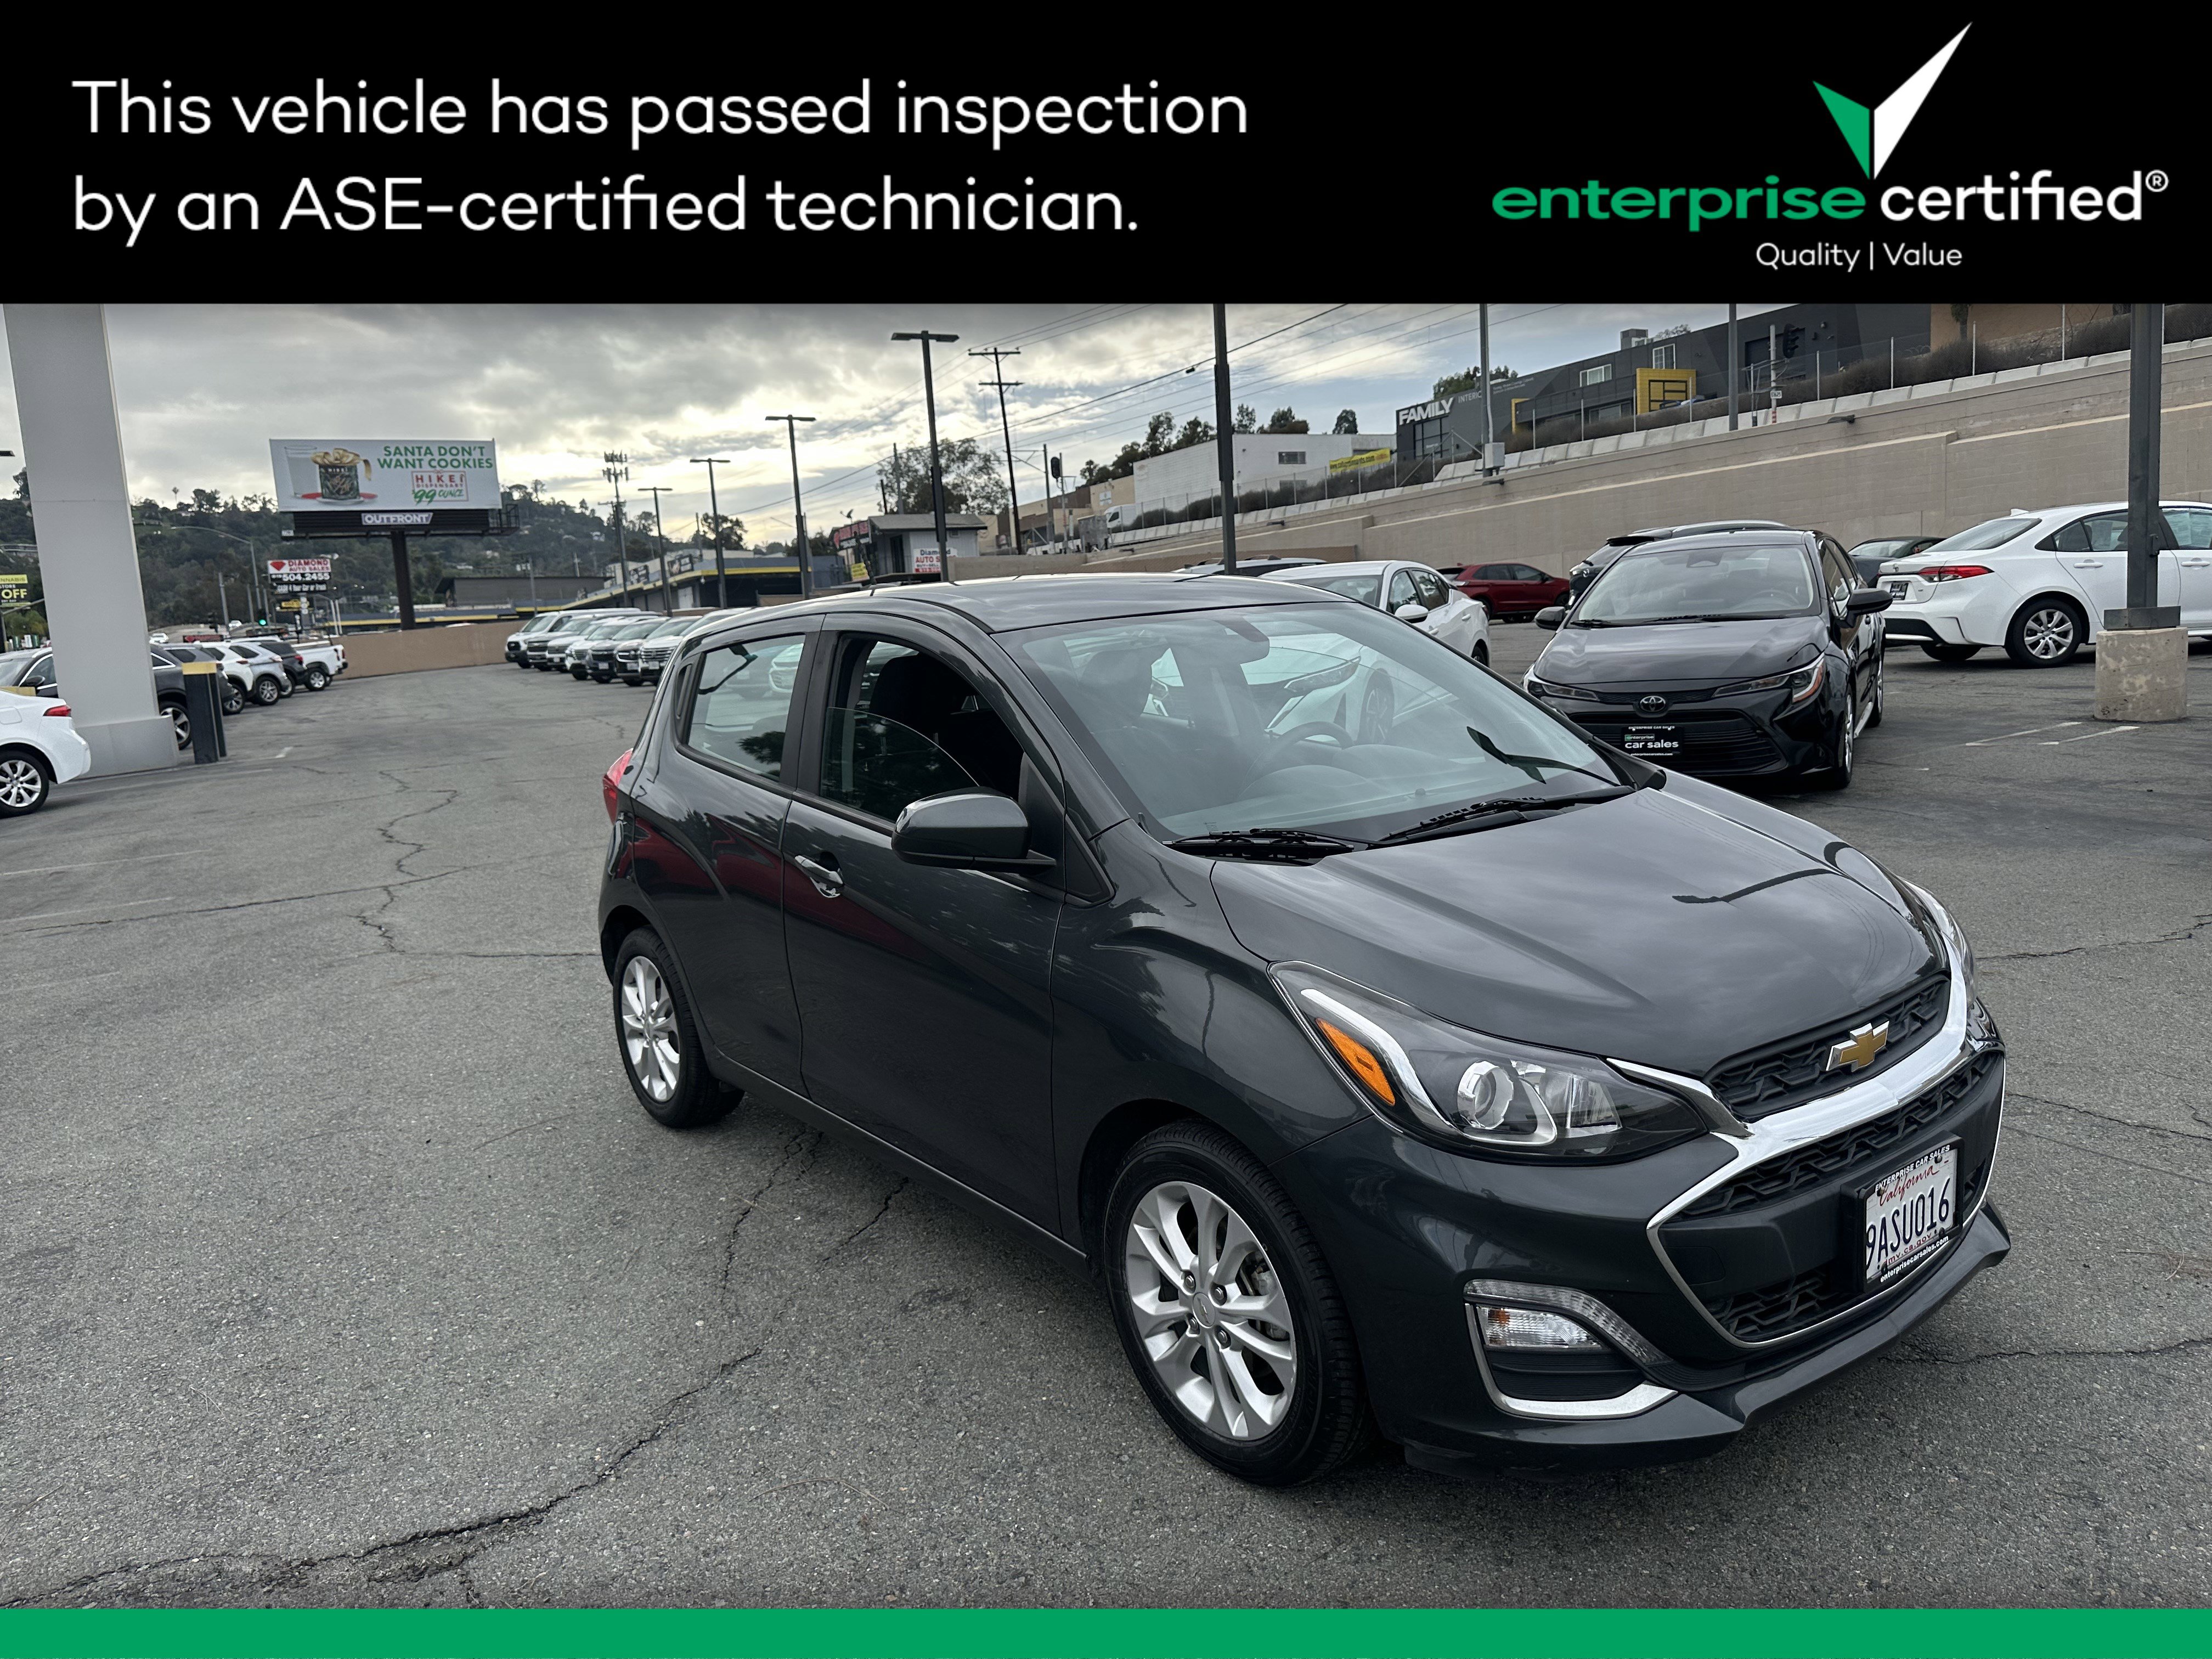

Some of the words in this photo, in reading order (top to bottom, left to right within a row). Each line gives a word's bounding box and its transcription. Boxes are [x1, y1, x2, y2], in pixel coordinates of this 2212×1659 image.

[1399, 397, 1455, 425] FAMILY
[1458, 390, 1482, 404] INTERIO
[384, 445, 433, 457] SANTA
[438, 445, 485, 456] DON'T
[377, 458, 424, 469] WANT
[428, 458, 493, 469] COOKIES
[364, 514, 428, 524] OUTFRONT
[1, 588, 27, 599] OFF
[1647, 739, 1679, 748] sales
[1875, 1163, 1915, 1192] ENTERPRISE
[1915, 1155, 1928, 1169] CAR
[1929, 1144, 1950, 1161] SALES
[1880, 1165, 1940, 1206] California
[1866, 1177, 1951, 1269] 9ASU016
[1880, 1235, 1949, 1283] enterprisecarsales.com
